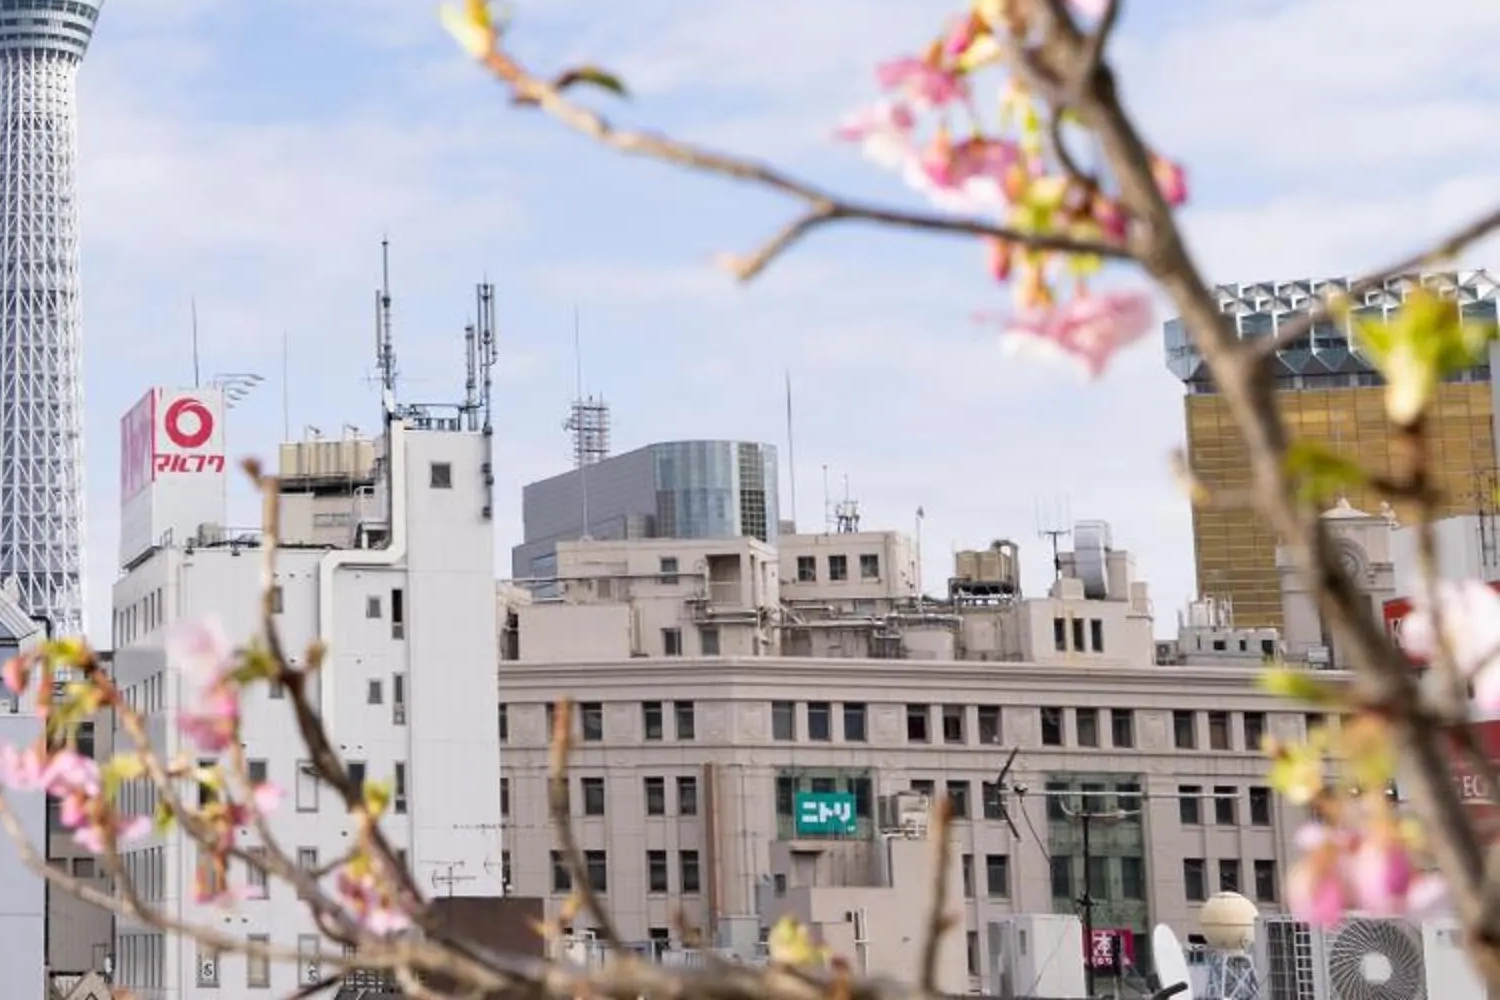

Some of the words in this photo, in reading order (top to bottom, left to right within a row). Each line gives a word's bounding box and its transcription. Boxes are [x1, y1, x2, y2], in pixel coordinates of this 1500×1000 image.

[153, 454, 225, 473] マルフク
[801, 801, 852, 823] ニトリ
